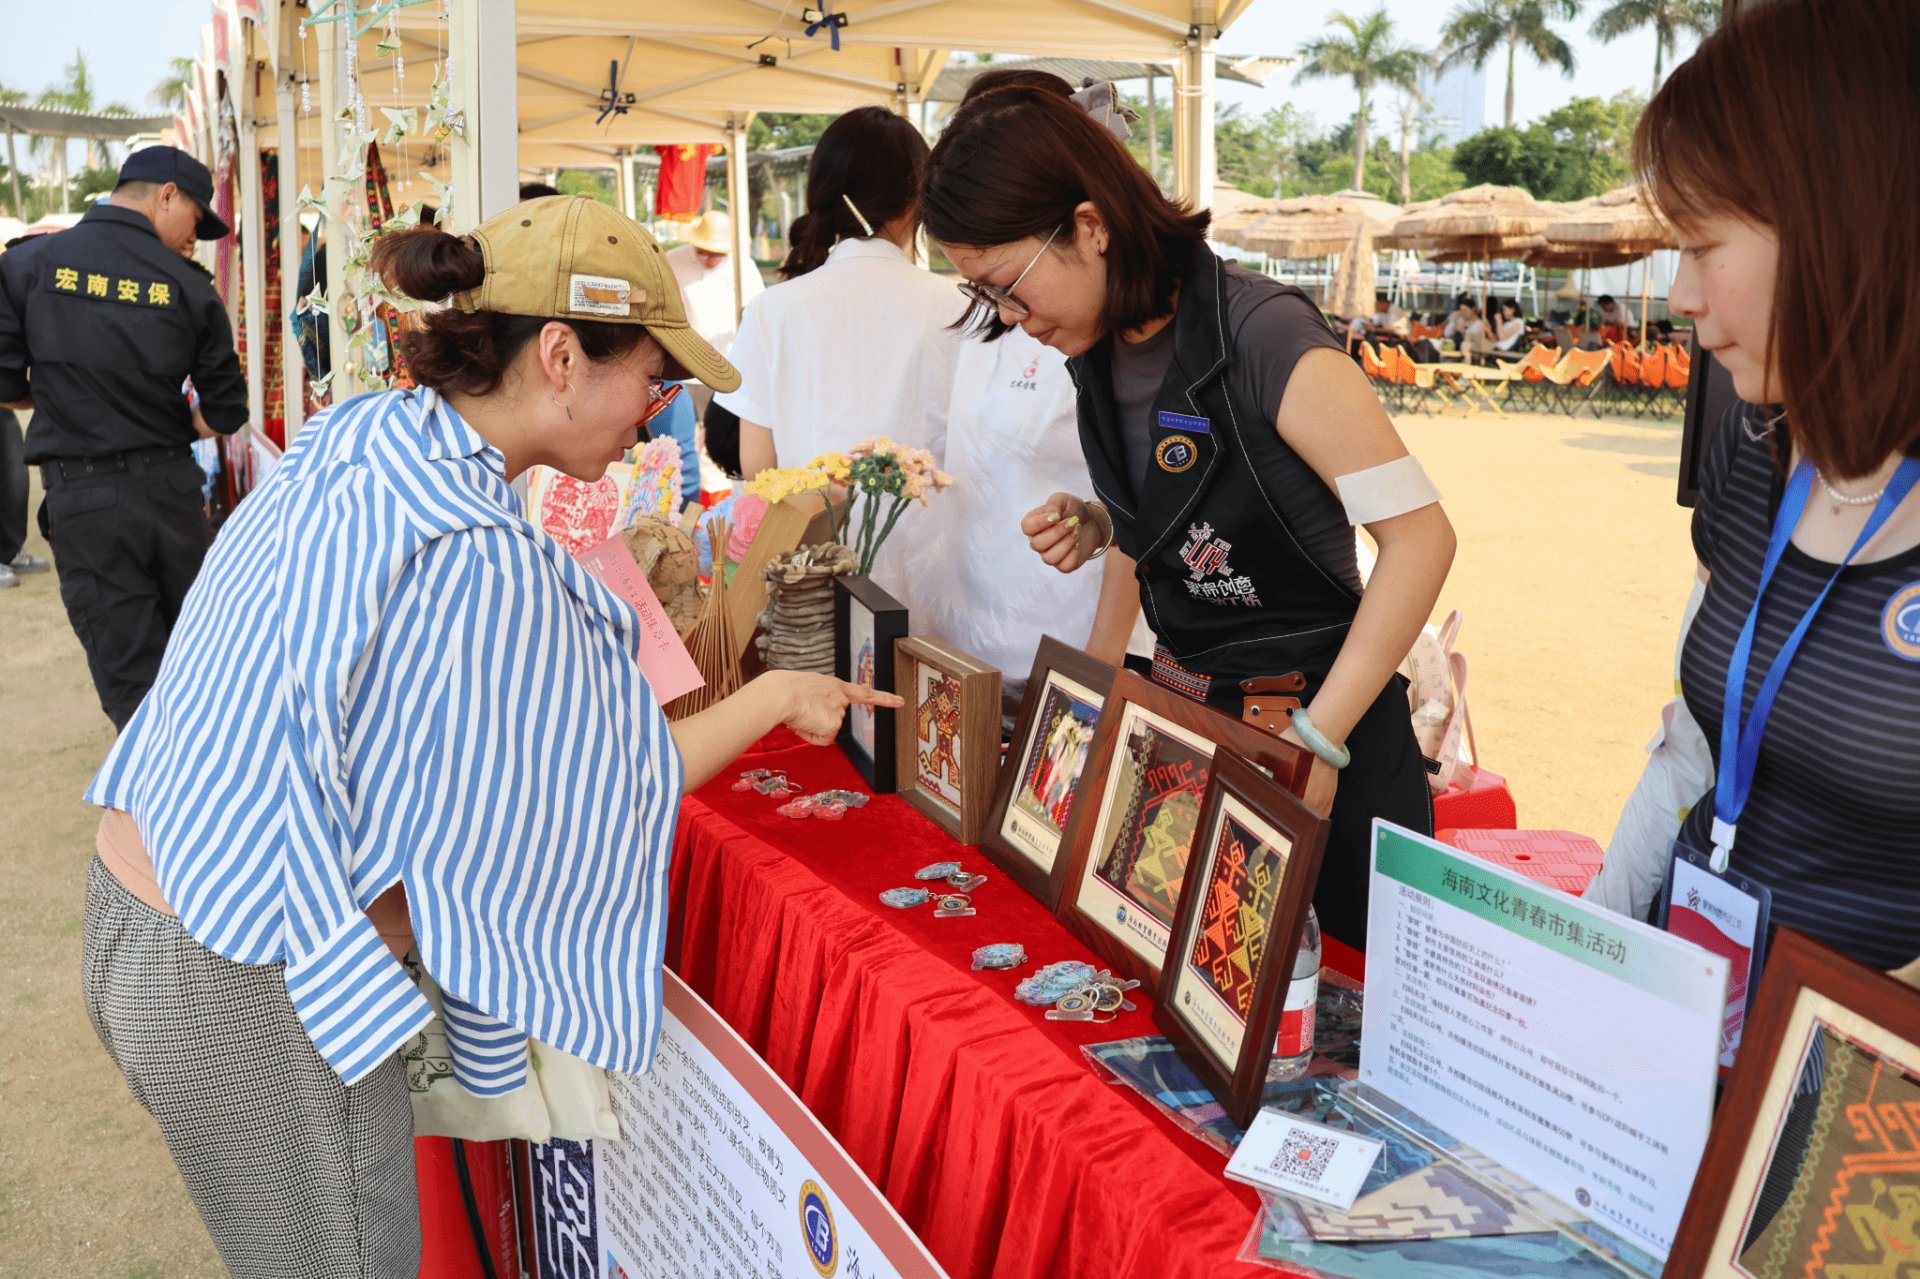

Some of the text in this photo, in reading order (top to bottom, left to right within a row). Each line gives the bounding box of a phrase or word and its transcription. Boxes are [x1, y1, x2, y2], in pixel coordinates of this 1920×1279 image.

[55, 267, 171, 304] 宏南安保
[1440, 865, 1629, 966] 海南文化青春市集活动
